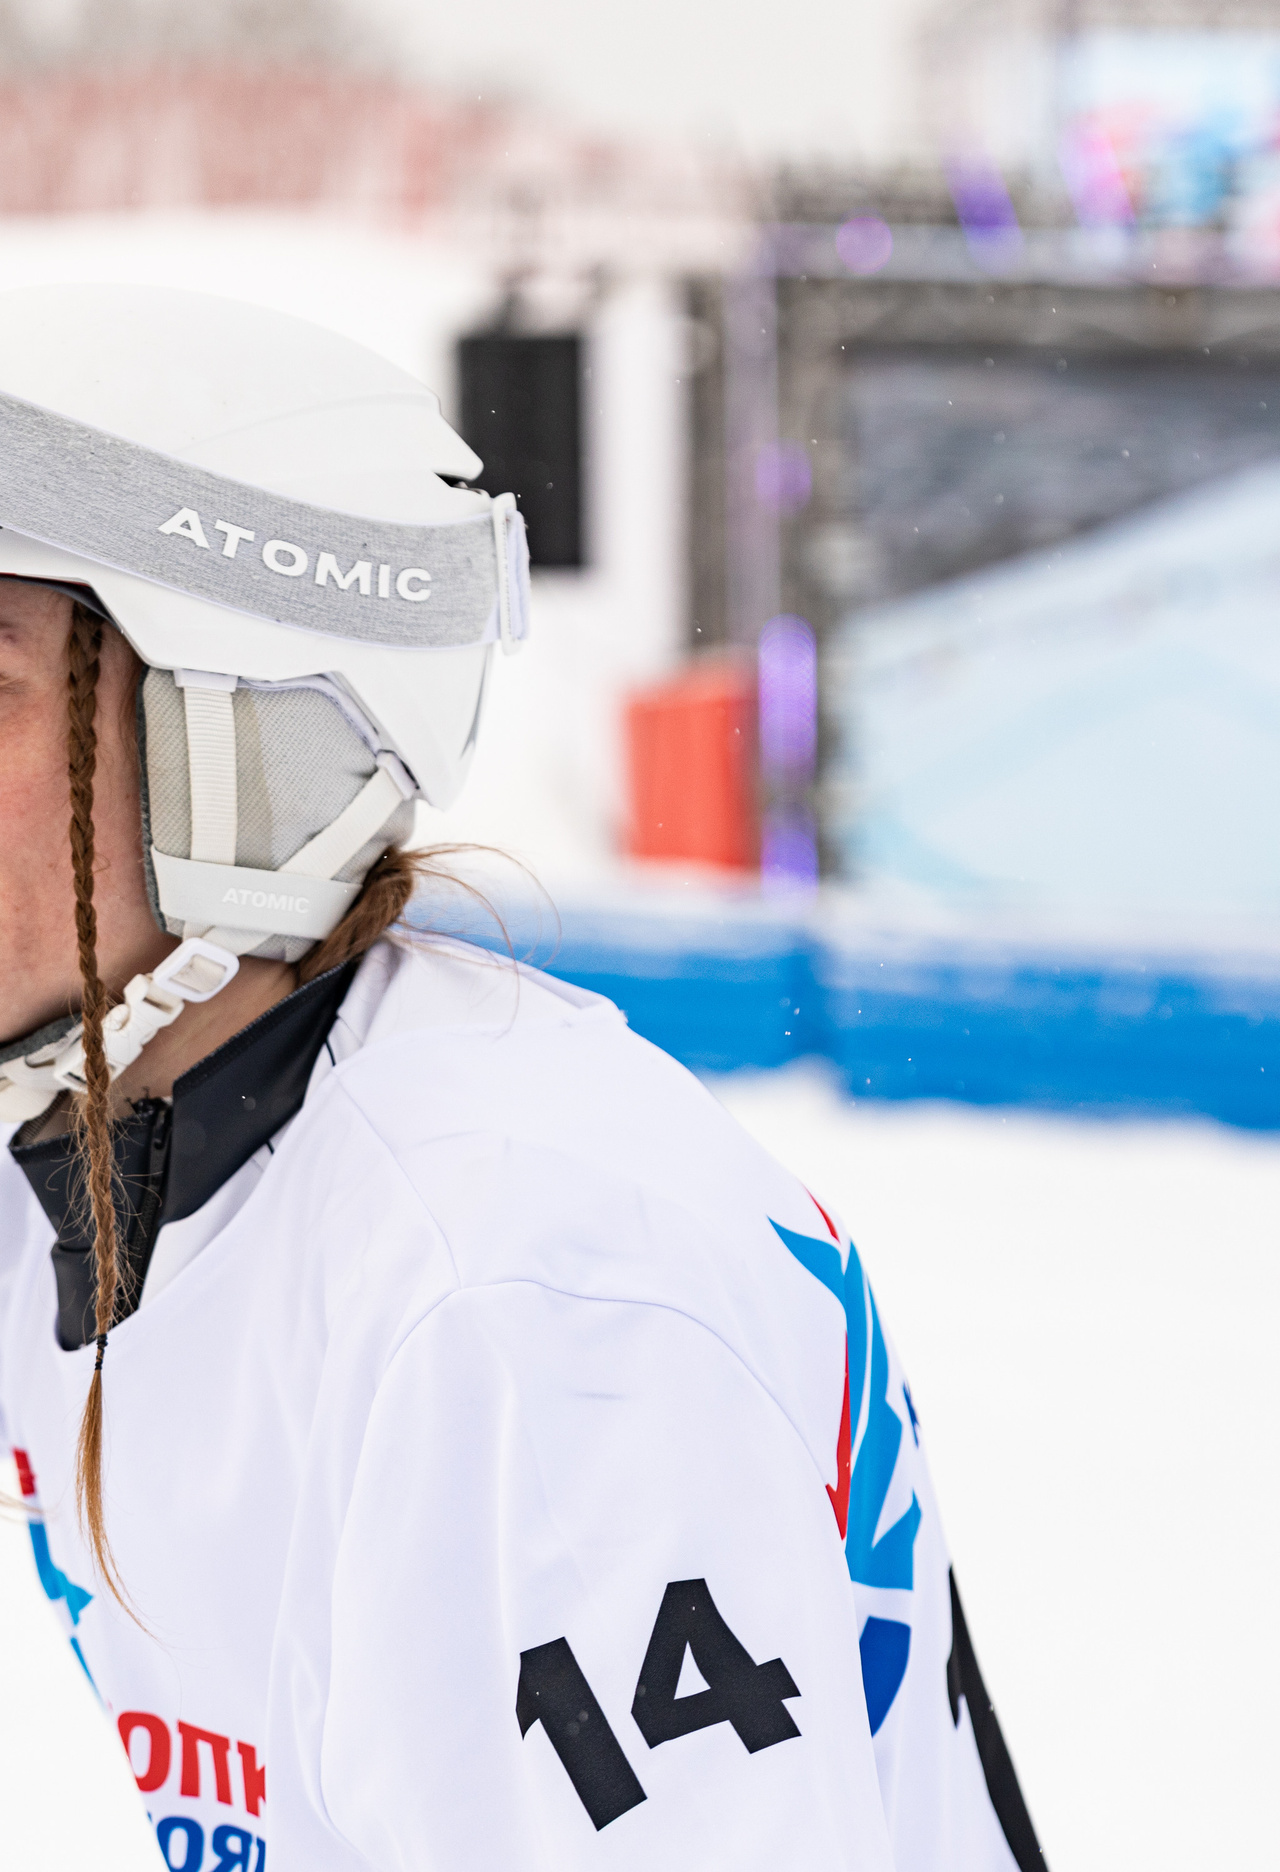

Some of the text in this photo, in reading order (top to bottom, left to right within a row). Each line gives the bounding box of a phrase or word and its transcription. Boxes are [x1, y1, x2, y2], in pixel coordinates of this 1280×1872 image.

[157, 506, 432, 602] ATOMIC
[222, 887, 310, 914] ATOMIC
[515, 1577, 803, 1832] 14
[111, 1705, 266, 1818] ОПК
